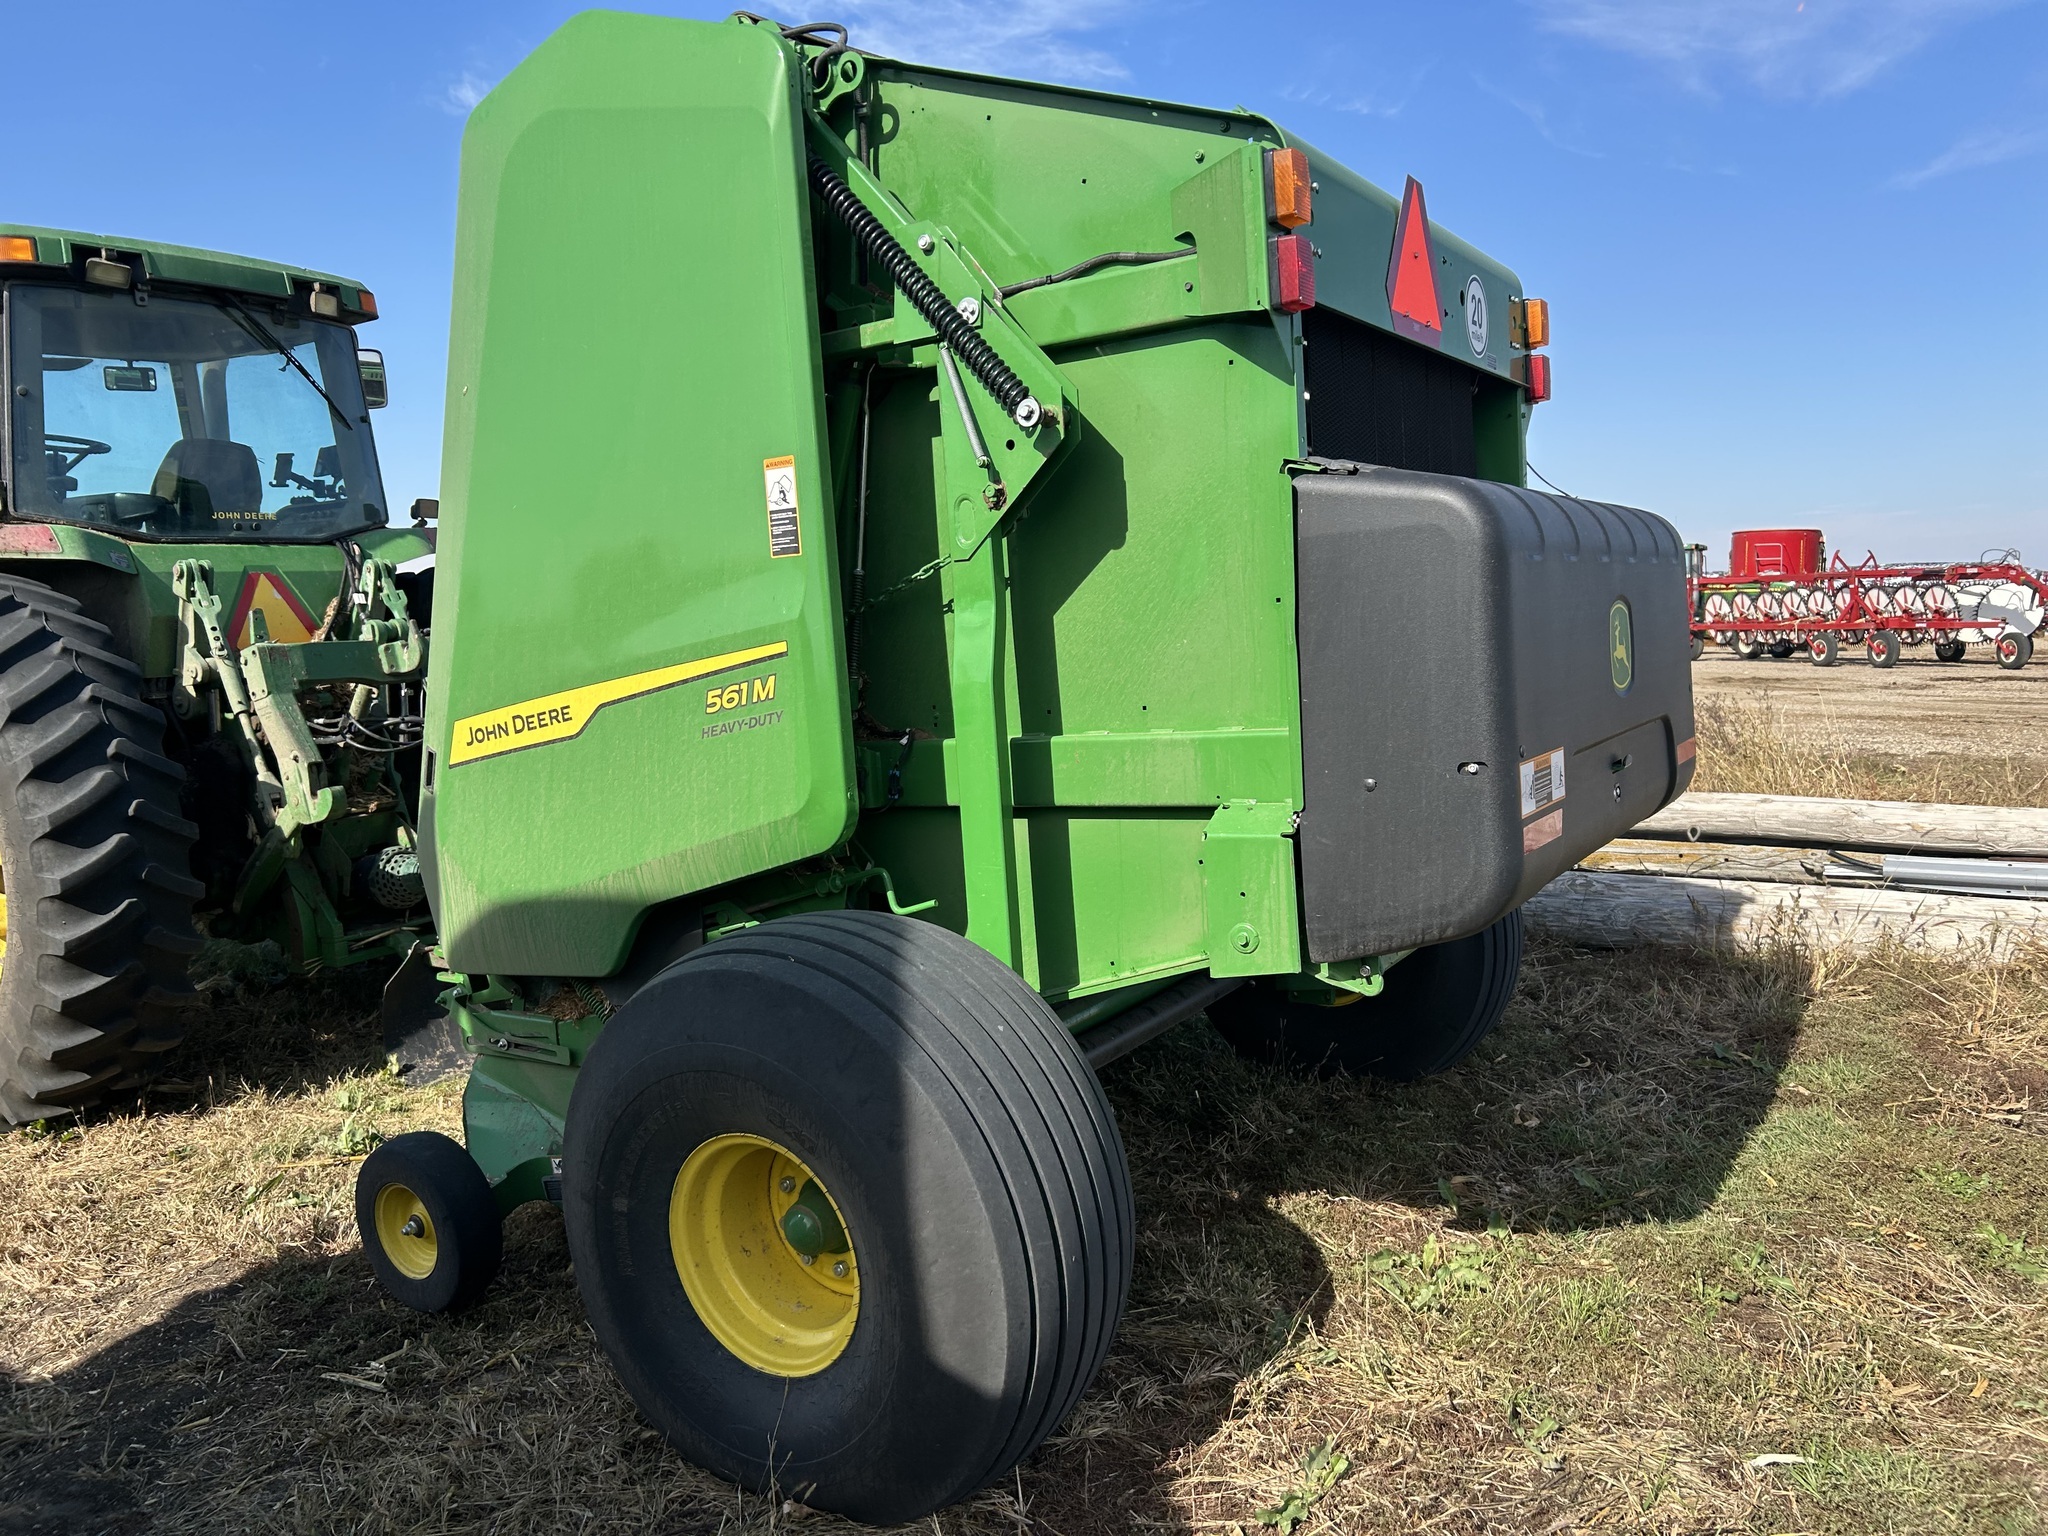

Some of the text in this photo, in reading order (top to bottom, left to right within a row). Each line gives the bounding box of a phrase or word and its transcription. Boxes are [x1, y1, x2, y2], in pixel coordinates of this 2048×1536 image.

[1471, 294, 1483, 329] 20
[211, 511, 277, 520] JOHN DEERE
[466, 705, 572, 746] JOHN DEERE
[701, 710, 785, 740] HEAVY-DUTY
